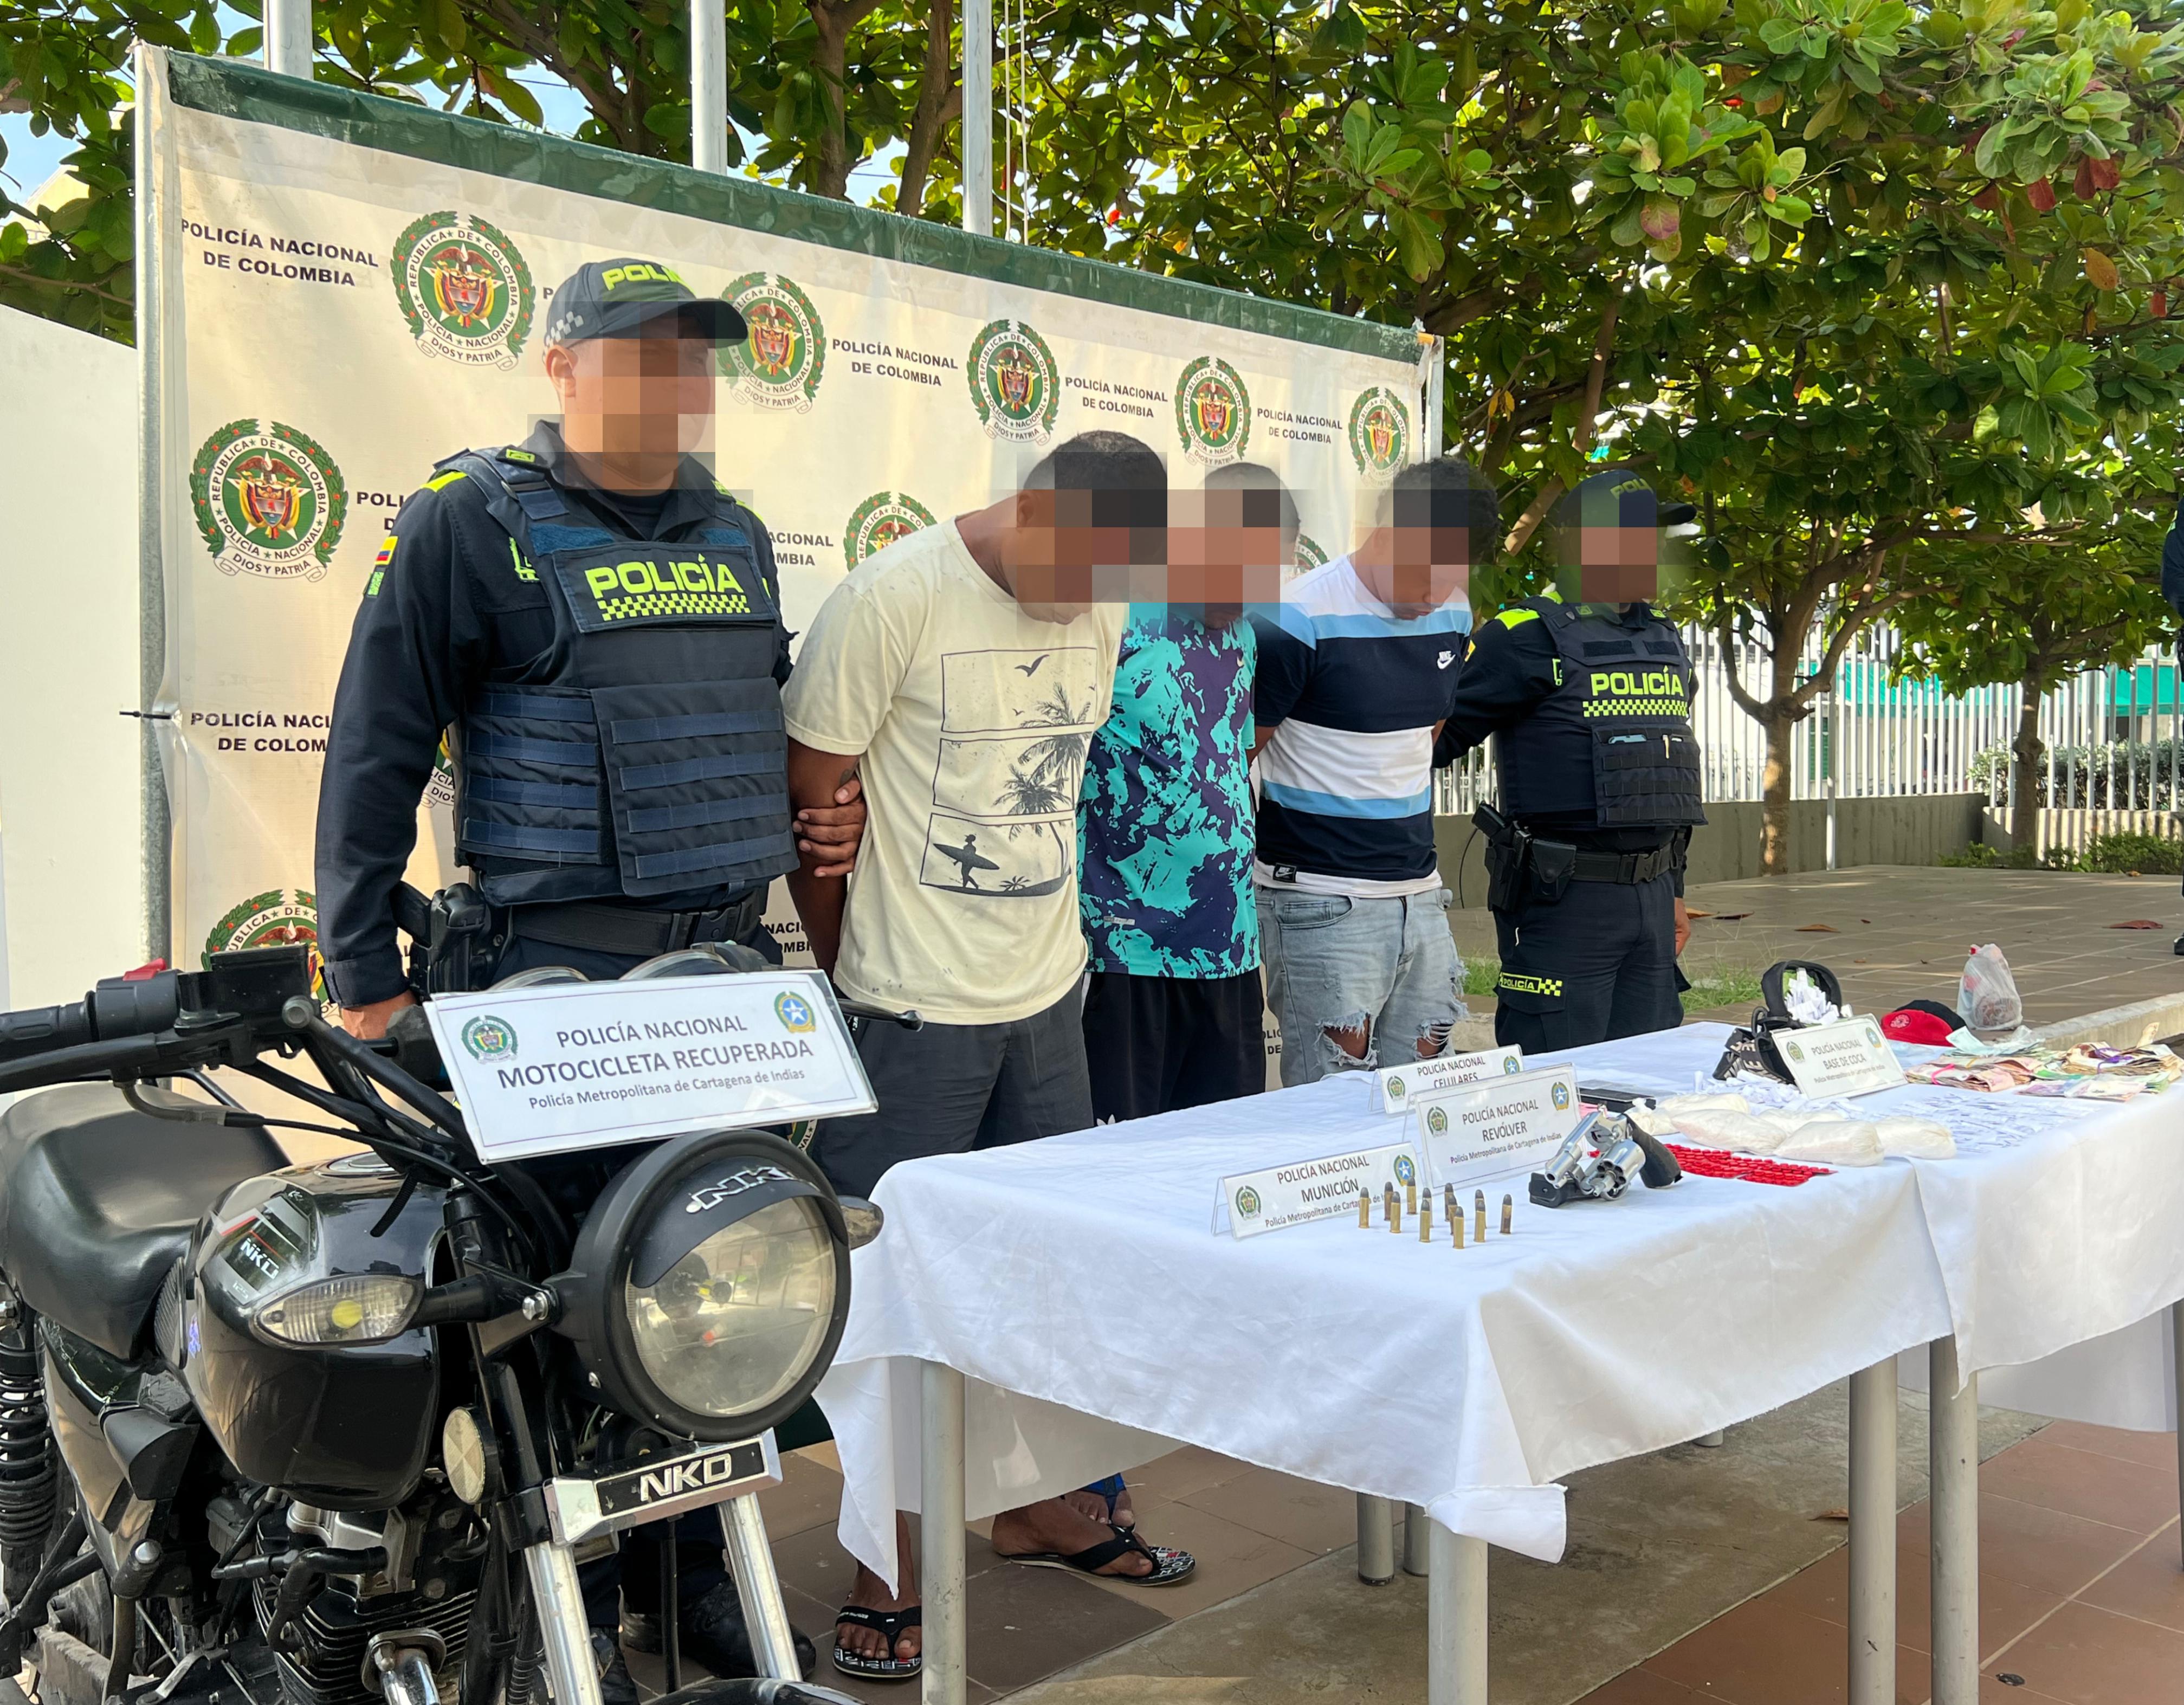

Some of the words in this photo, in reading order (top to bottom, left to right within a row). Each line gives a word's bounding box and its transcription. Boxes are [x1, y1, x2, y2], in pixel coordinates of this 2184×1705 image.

[182, 218, 263, 248] POLICÍA
[270, 238, 378, 267] NACIONAL
[203, 251, 230, 269] DE
[238, 258, 355, 286] COLOMBIA
[458, 230, 473, 241] DE
[485, 243, 518, 306] COLOMBIA
[602, 264, 696, 296] POLI
[466, 318, 514, 347] NACIONAL
[767, 288, 780, 298] DE
[788, 299, 812, 356] COLOMBIA
[467, 349, 502, 363] PATRIA
[832, 338, 892, 357] POLICÍA
[896, 347, 958, 369] NACIONAL
[773, 367, 809, 393] NACIONAL
[851, 361, 871, 374] DE
[877, 365, 941, 386] COLOMBIA
[1027, 343, 1048, 393] COLOMBIA
[772, 395, 800, 407] PATRIA
[1065, 377, 1110, 393] POLICÍA
[1114, 384, 1168, 402] NACIONAL
[1016, 404, 1046, 428] NACIONAL
[1083, 397, 1095, 408] DE
[1099, 400, 1154, 417] COLOMBIA
[1257, 408, 1293, 423] POLICÍA
[1296, 414, 1342, 430] NACIONAL
[1269, 427, 1280, 437] DE
[1282, 429, 1331, 444] COLOMBIA
[261, 438, 276, 449] DE
[289, 449, 326, 514] COLOMBIA
[357, 491, 404, 508] POLI
[768, 532, 833, 547] ACIONAL
[275, 527, 321, 559] NACIONAL
[275, 560, 311, 575] PATRIA
[776, 553, 815, 566] MBIA
[585, 553, 744, 598] POLICÍA
[1591, 666, 1684, 696] POLICÍA
[191, 711, 276, 728] POLICÍA
[284, 715, 330, 728] NACI
[218, 738, 246, 751] DE
[254, 739, 326, 752] COLOM
[228, 913, 271, 951] ÚBLICA
[285, 907, 301, 915] DE
[765, 922, 799, 934] NACI
[1504, 979, 1535, 990] POLICÍA
[557, 1021, 641, 1048] POLICÍA
[645, 1015, 747, 1039] NACIONAL
[1834, 1039, 1863, 1052] NACIONAL
[497, 1053, 670, 1089] MOTOCICLETA
[674, 1039, 813, 1070] RECUPERADA
[1417, 1062, 1447, 1076] POLICÍA
[1448, 1056, 1485, 1070] NACIONAL
[1823, 1057, 1840, 1069] BASE
[1841, 1056, 1849, 1067] DE
[1849, 1054, 1866, 1065] COCA
[529, 1093, 574, 1109] Policía
[578, 1084, 671, 1106] Metropolitana
[675, 1080, 690, 1092] de
[693, 1074, 752, 1093] Cartagena
[755, 1073, 769, 1084] de
[772, 1068, 805, 1081] Indias
[1463, 1106, 1495, 1125] POLICÍA
[1497, 1099, 1539, 1118] NACIONAL
[1482, 1120, 1528, 1142] REVÓLVER
[1277, 1164, 1317, 1184] POLICÍA
[1319, 1155, 1369, 1176] NACIONAL
[1301, 1176, 1359, 1203] MUNICIÓN
[1287, 1206, 1332, 1224] Metropolitana
[1333, 1203, 1341, 1213] de
[1373, 1195, 1380, 1203] de
[240, 1237, 279, 1280] NKD
[640, 1453, 732, 1501] NKD
